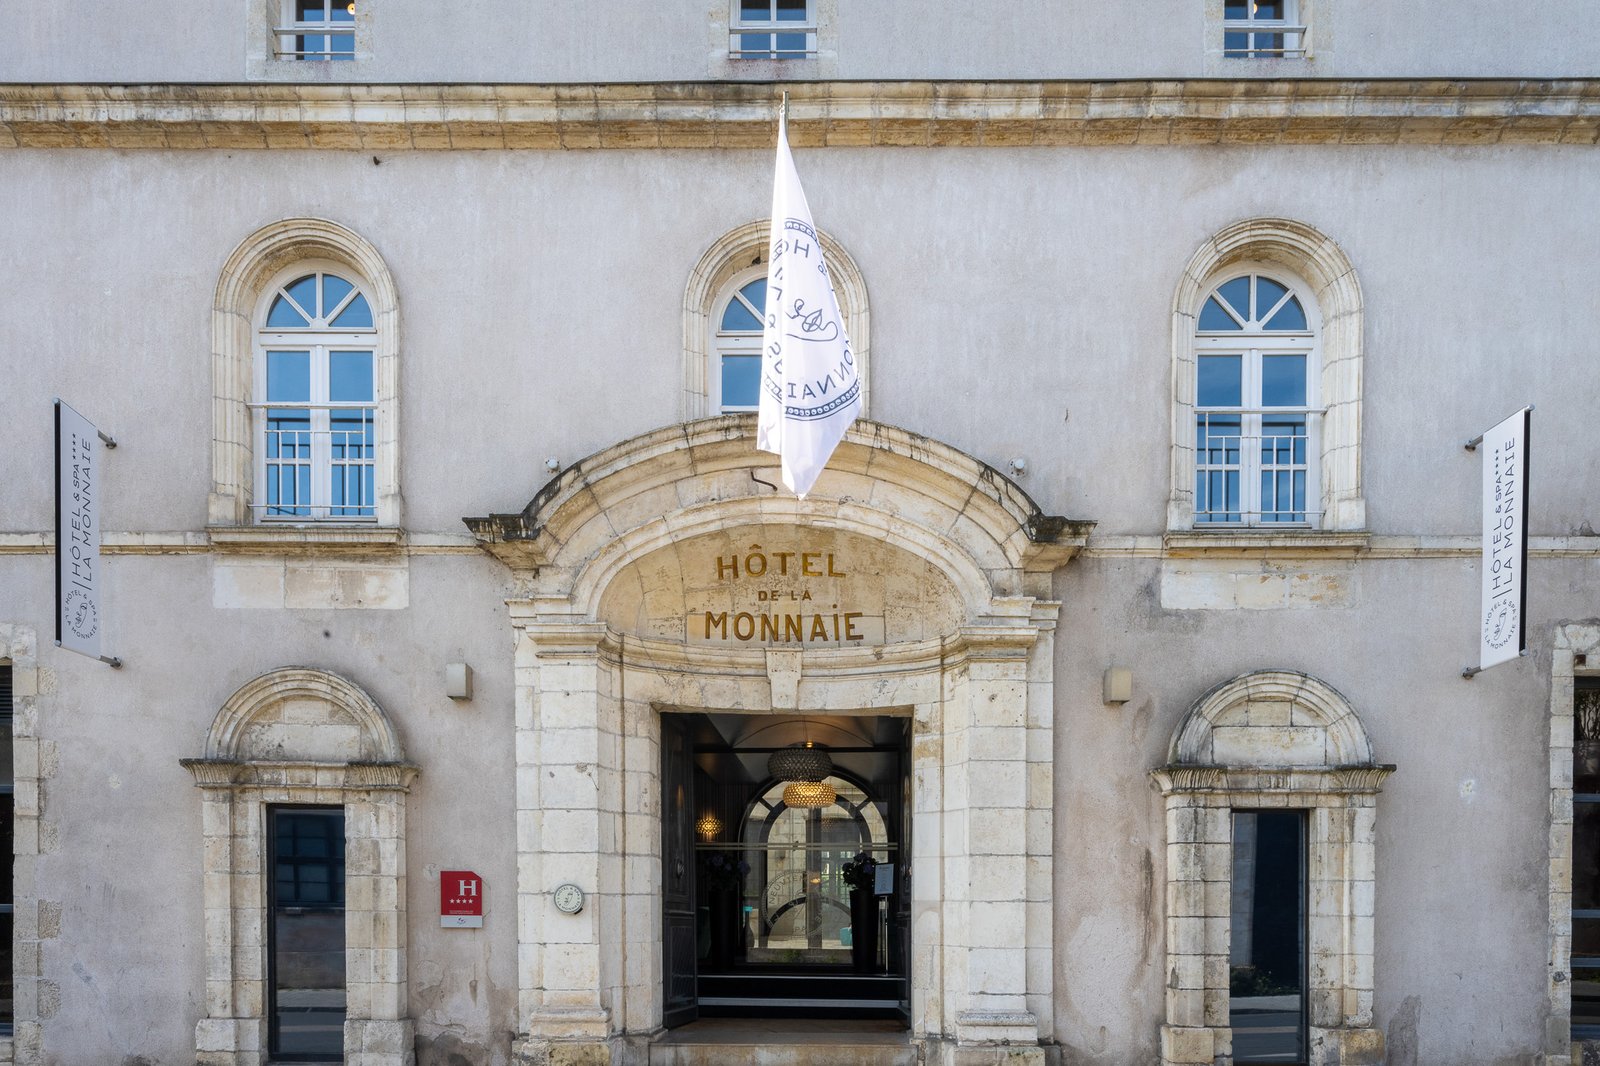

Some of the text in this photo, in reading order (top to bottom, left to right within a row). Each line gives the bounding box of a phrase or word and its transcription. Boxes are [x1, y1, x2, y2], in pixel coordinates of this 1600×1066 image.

[73, 493, 80, 502] &
[82, 438, 92, 582] LA MONNAIE
[1495, 504, 1502, 514] &
[1503, 437, 1515, 585] LA MONNAIE
[69, 508, 81, 577] HÔTEL
[1490, 518, 1502, 590] HÔTEL
[717, 544, 846, 580] HÔTEL
[758, 590, 812, 602] DE LA
[705, 603, 864, 642] MONNAIE
[458, 879, 478, 897] H
